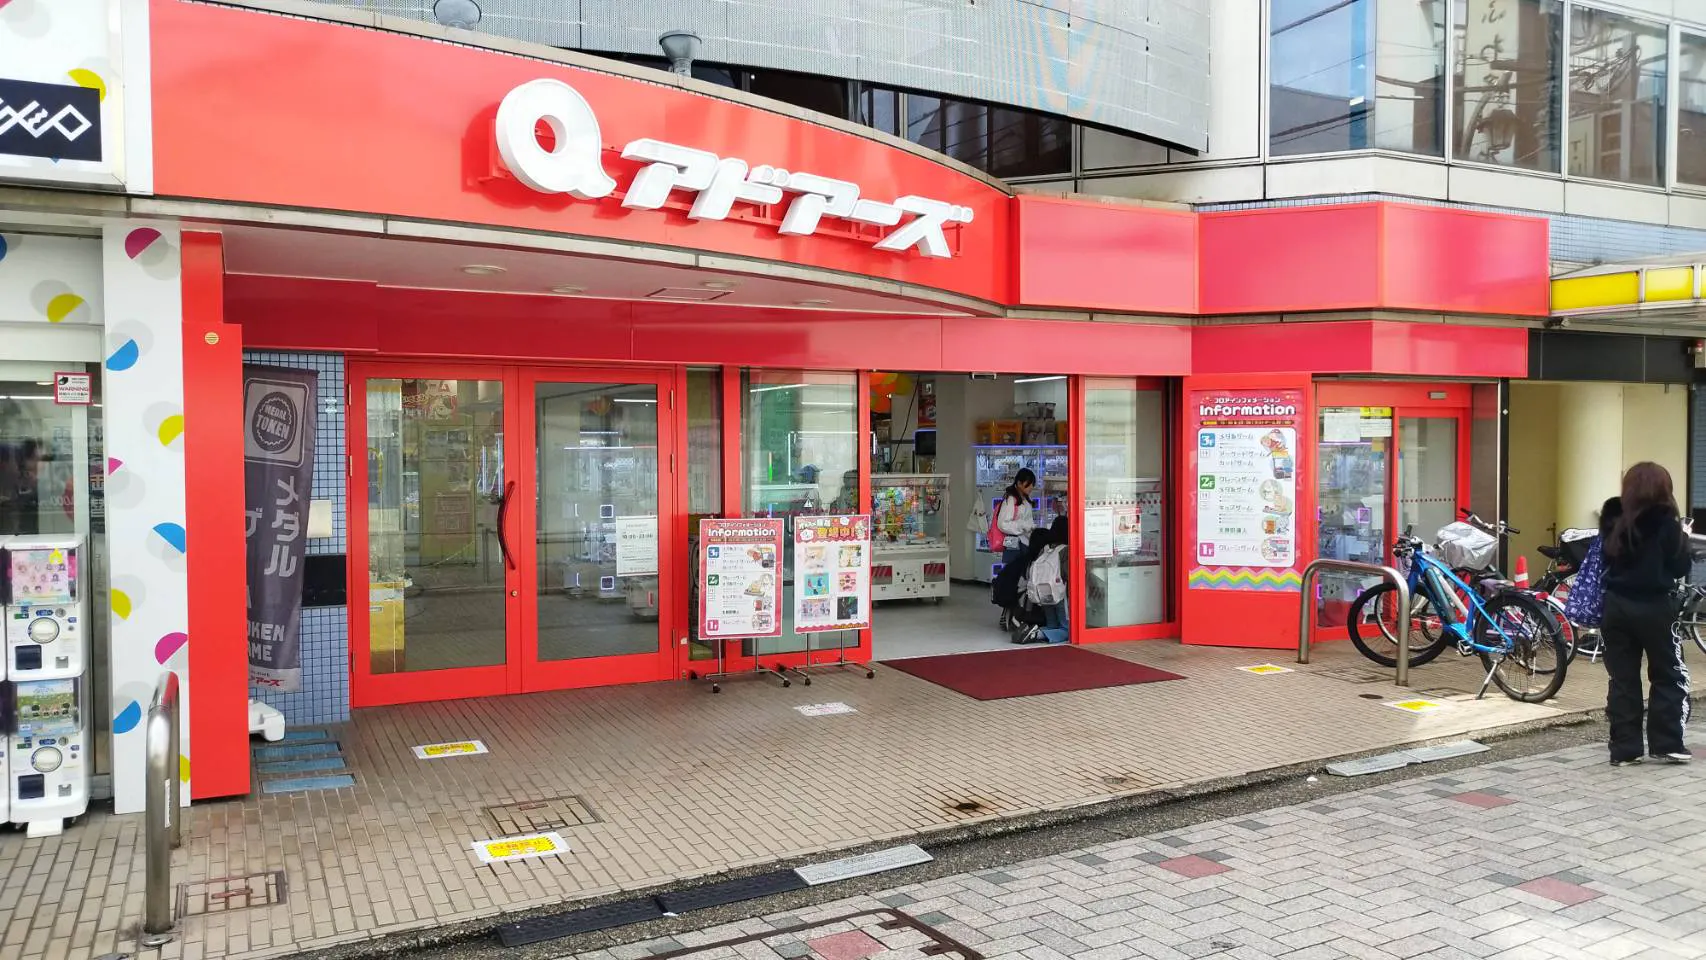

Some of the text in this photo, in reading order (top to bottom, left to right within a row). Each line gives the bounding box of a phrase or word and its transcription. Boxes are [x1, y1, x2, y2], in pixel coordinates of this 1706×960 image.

[620, 138, 975, 259] アドアーズ
[265, 404, 287, 421] MEDAL
[1199, 404, 1296, 417] Information
[256, 414, 290, 440] TOKEN
[1201, 476, 1215, 489] 2F
[263, 475, 300, 578] メダル
[708, 528, 777, 537] Information
